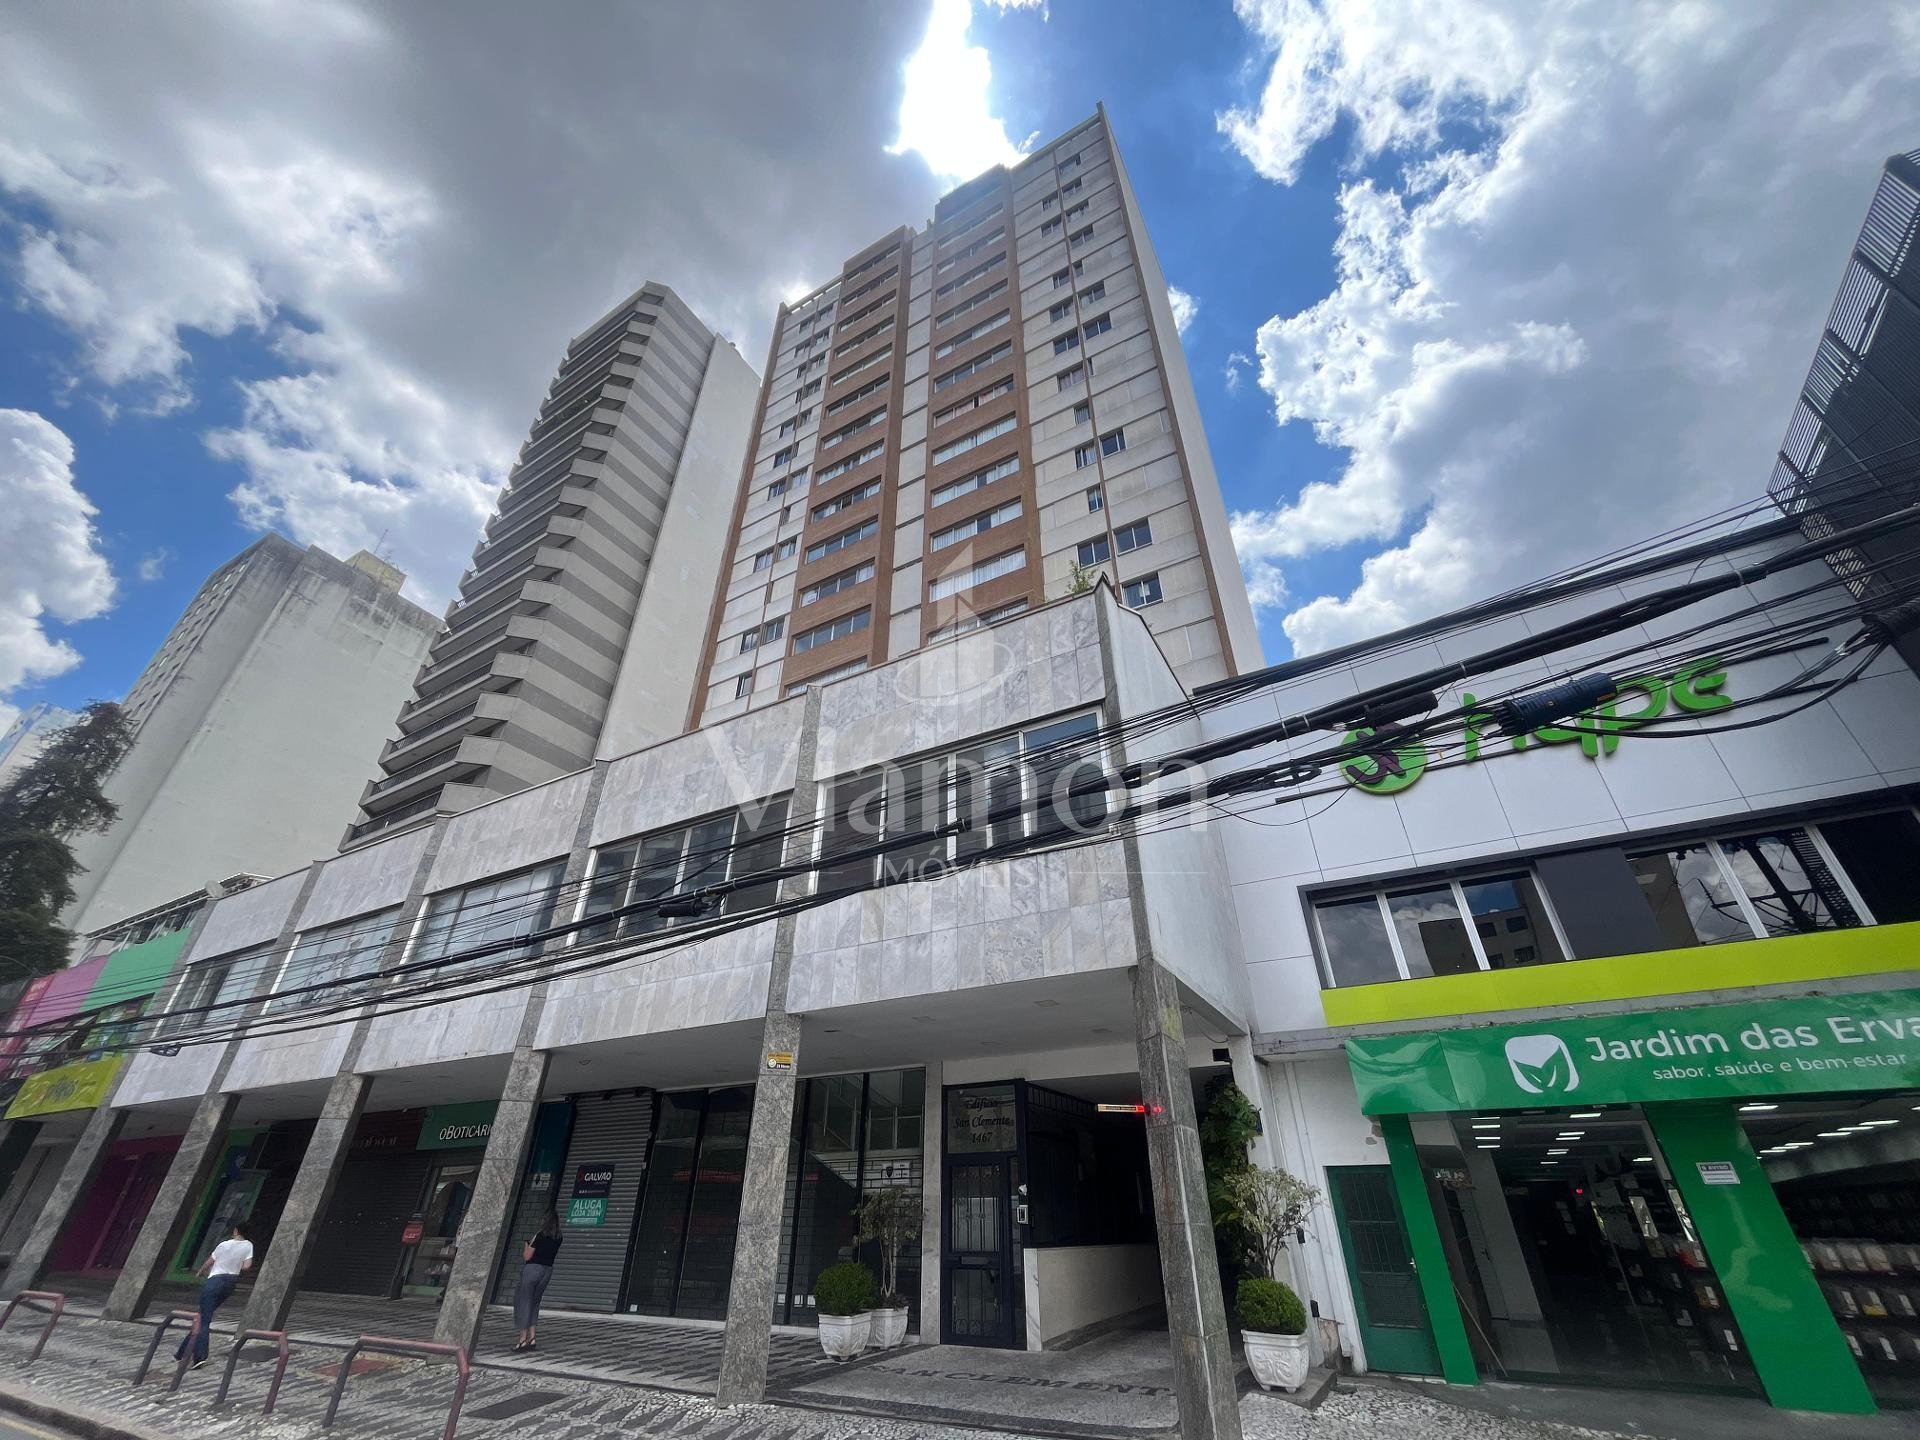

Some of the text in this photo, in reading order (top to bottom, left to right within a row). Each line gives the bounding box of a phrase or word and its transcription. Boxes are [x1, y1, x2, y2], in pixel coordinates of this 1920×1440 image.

[1585, 1028, 1731, 1062] Jardim
[1740, 1022, 1819, 1051] das
[1715, 1058, 1774, 1077] saúde
[1780, 1061, 1792, 1073] e
[1799, 1051, 1907, 1072] bem-estar
[971, 1131, 993, 1144] 1467
[573, 1199, 602, 1210] ALUGA
